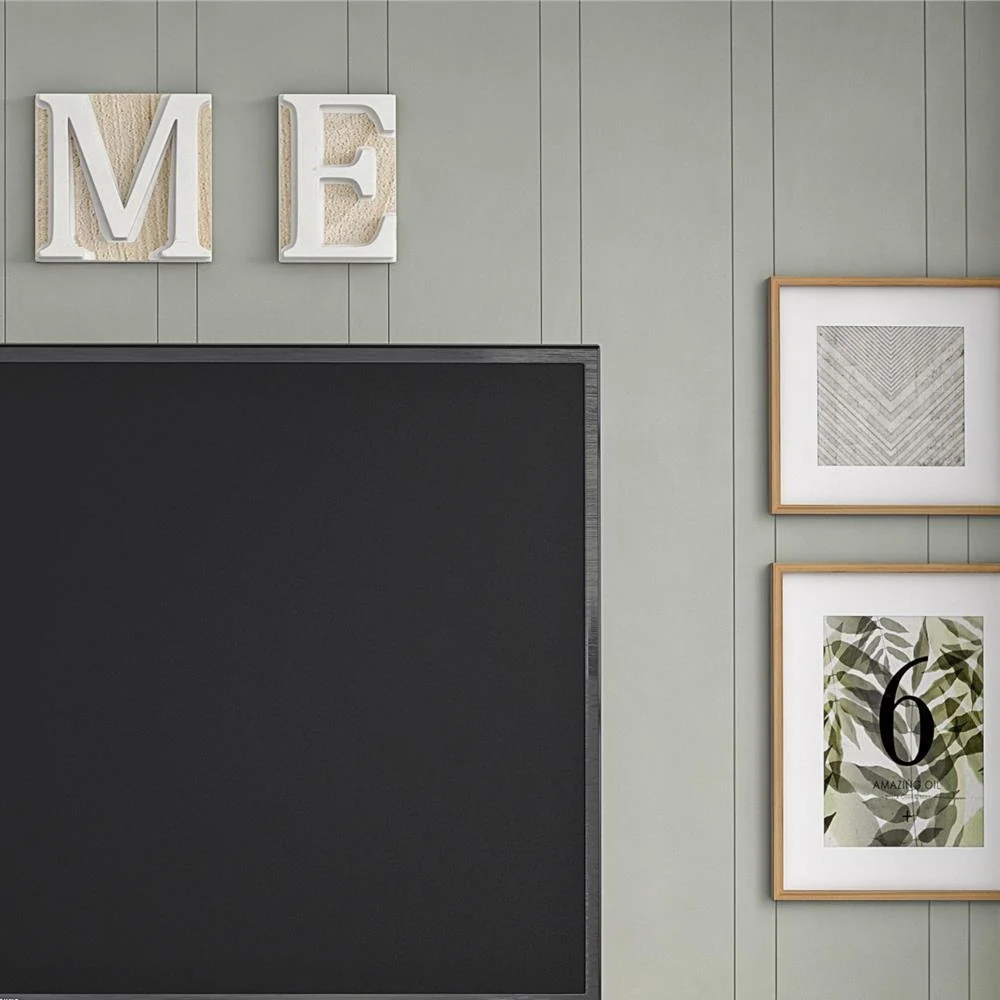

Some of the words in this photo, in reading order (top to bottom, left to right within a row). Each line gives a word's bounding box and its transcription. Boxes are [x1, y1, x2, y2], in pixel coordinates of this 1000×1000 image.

[879, 655, 935, 767] 6
[873, 780, 921, 790] AMAZING
[925, 780, 941, 790] OIL
